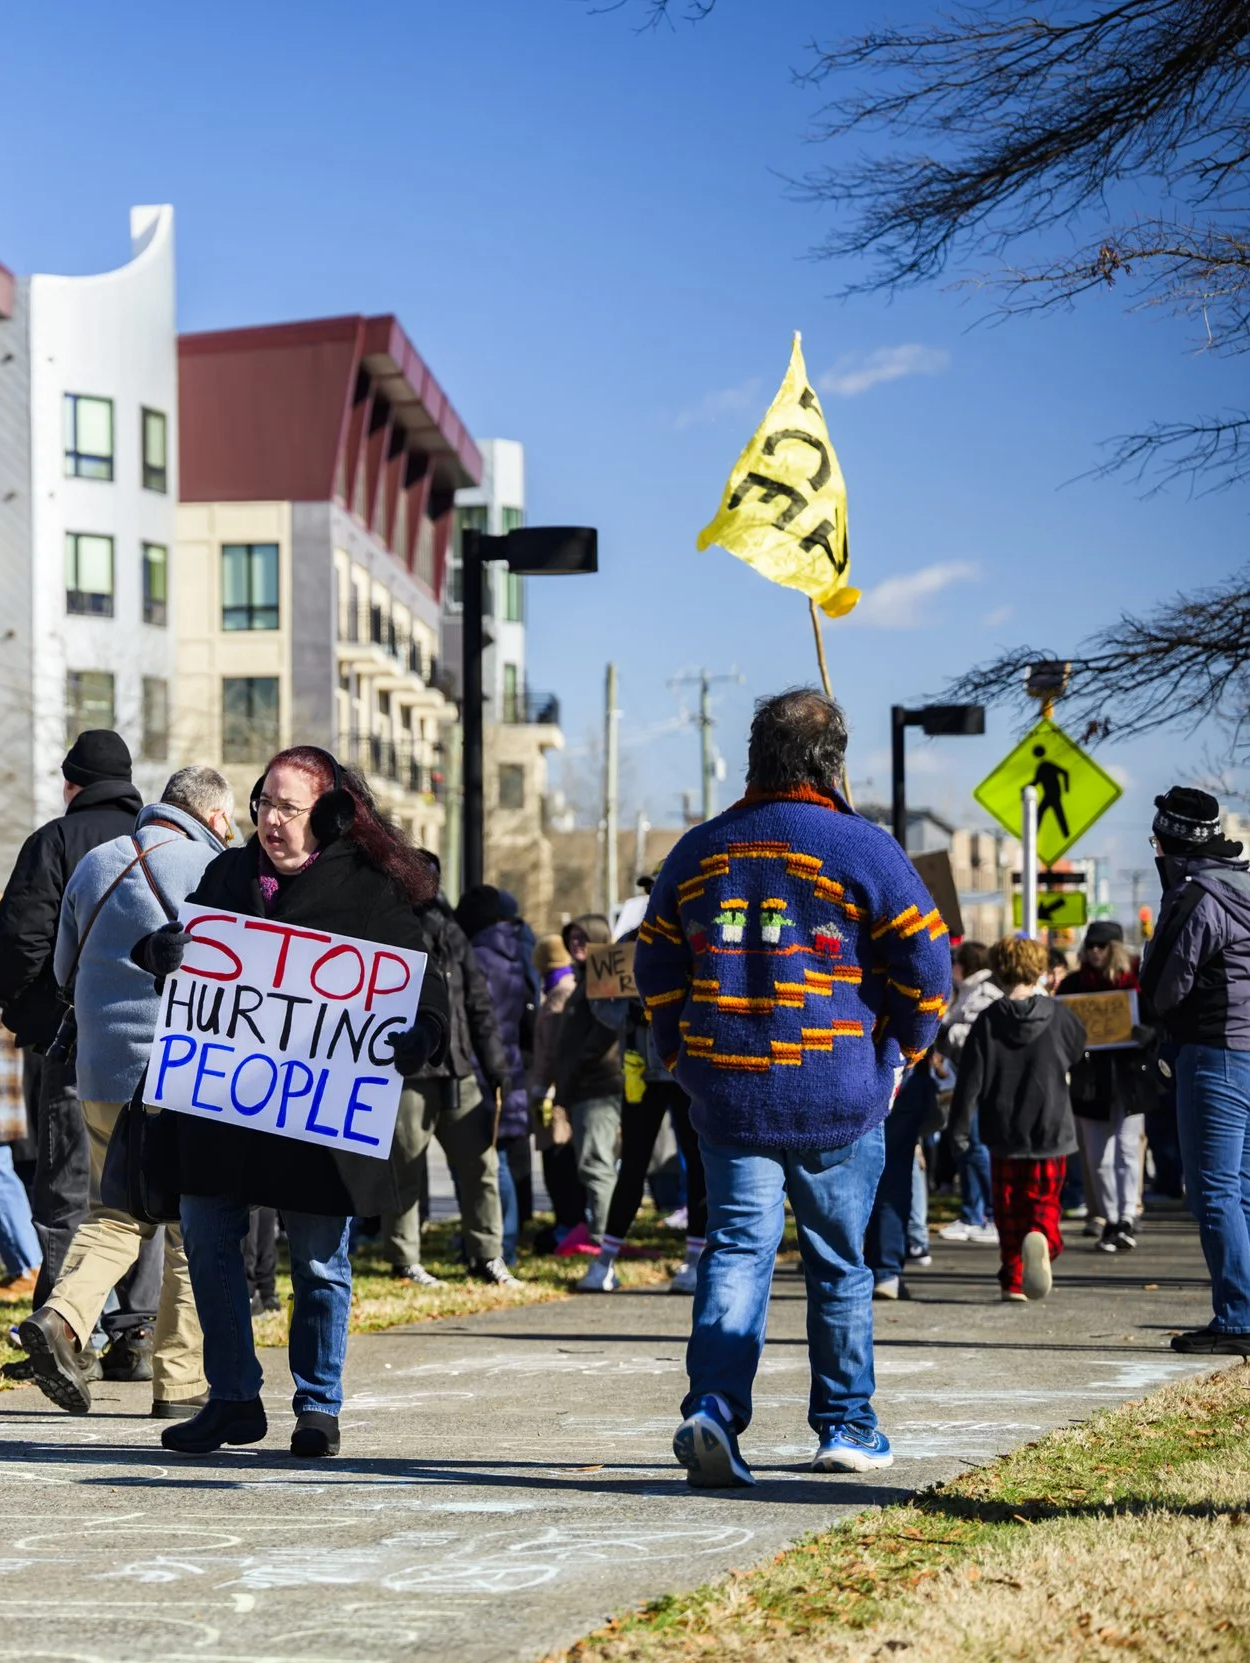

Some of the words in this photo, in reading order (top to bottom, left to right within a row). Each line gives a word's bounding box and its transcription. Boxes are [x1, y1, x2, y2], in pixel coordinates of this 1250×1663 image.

[180, 914, 410, 1011] STOP
[591, 949, 625, 981] WE
[165, 978, 407, 1067] HURTING
[154, 1034, 389, 1146] PEOPLE
